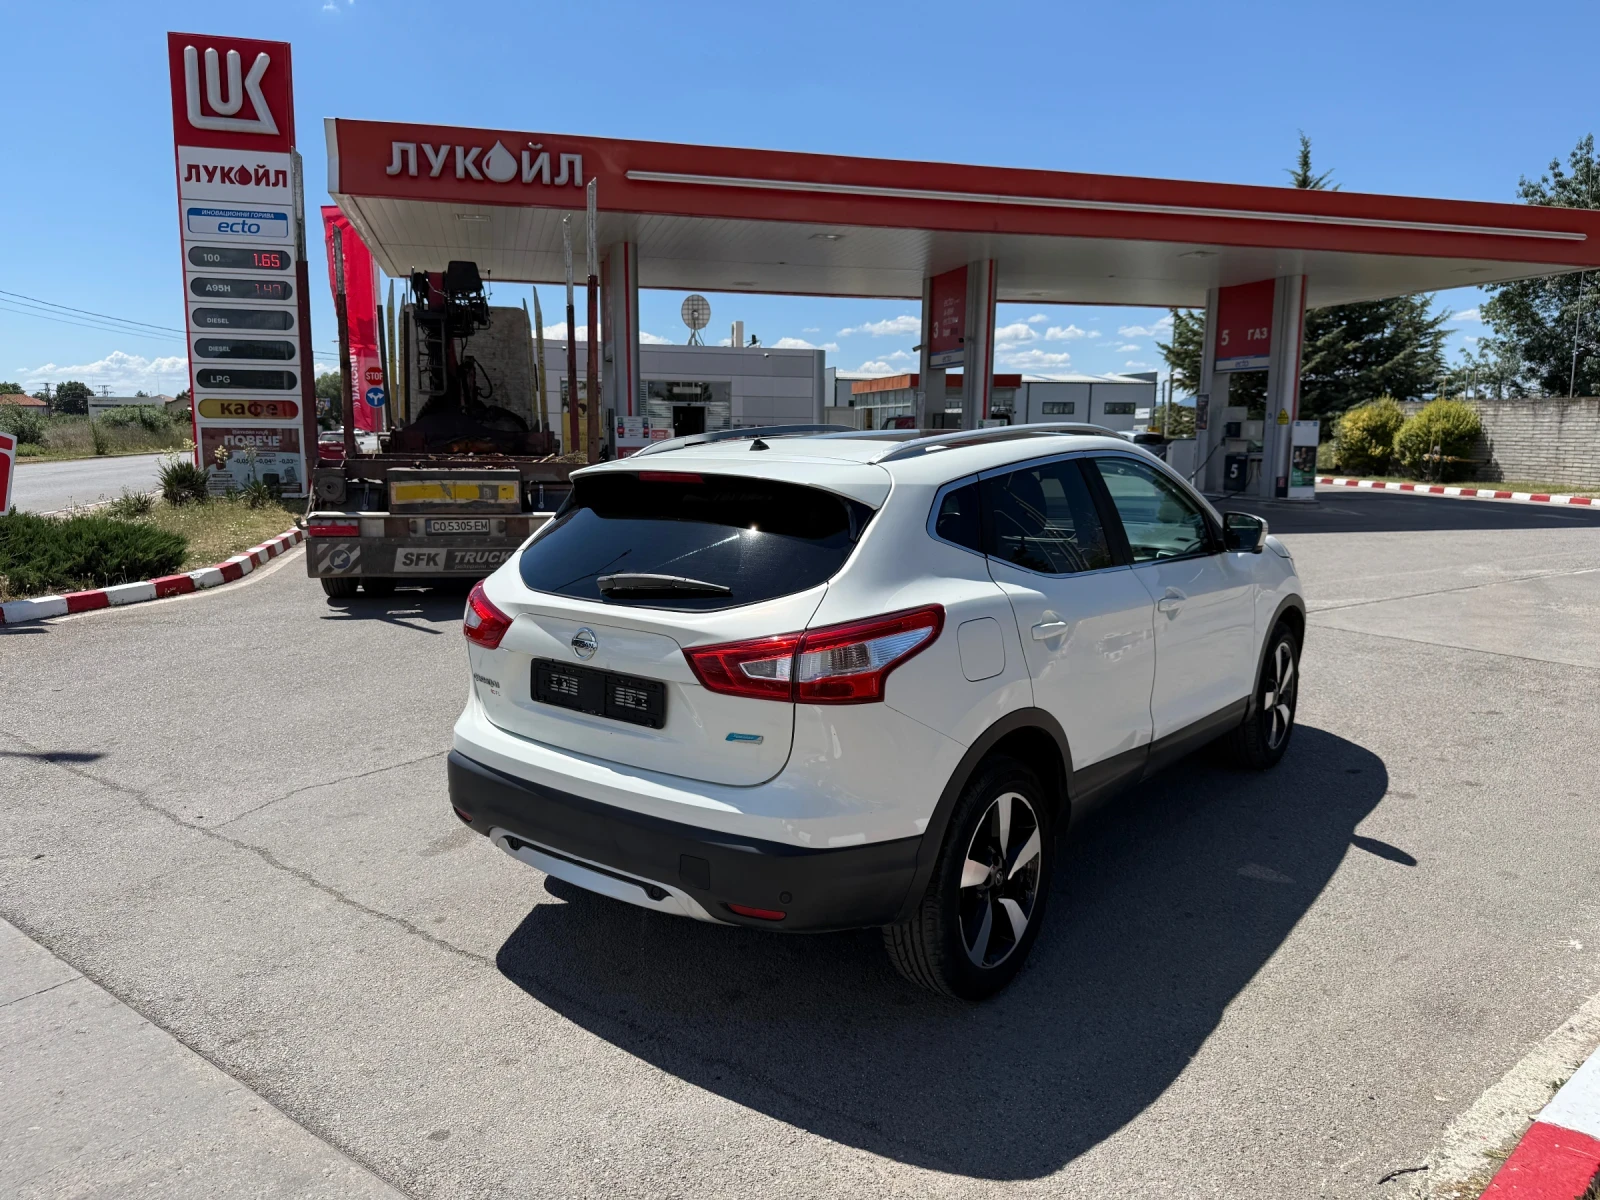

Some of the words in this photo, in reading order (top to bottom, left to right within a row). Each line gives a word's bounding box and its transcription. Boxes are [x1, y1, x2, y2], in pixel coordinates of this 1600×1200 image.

[386, 138, 583, 187] ЛУКОЙЛ
[185, 164, 287, 187] ЛУКОЙЛ
[201, 209, 250, 218] ИНОВАЦИОННИ
[217, 220, 261, 234] ecto
[203, 253, 220, 262] 100
[253, 253, 280, 268] 1.65
[206, 317, 229, 325] DIESEL
[1220, 329, 1230, 346] 5
[1247, 327, 1268, 341] ГАЗ
[210, 375, 231, 384] LPG
[224, 434, 280, 447] ПОВЕЧЕ
[1229, 463, 1238, 479] 5
[402, 552, 439, 567] SFK
